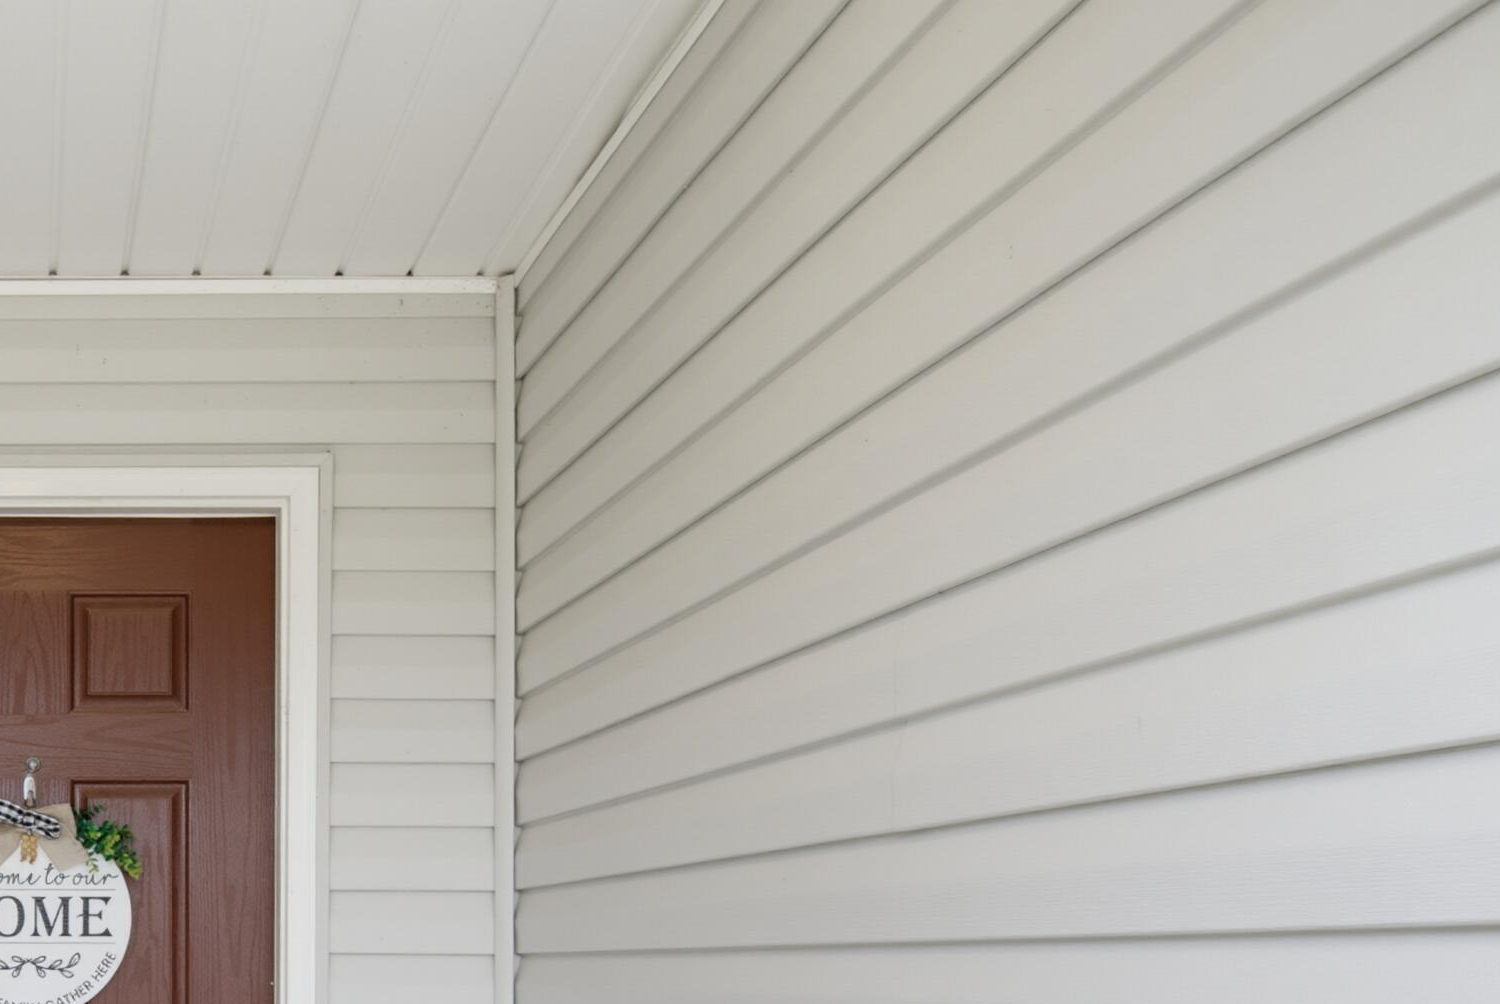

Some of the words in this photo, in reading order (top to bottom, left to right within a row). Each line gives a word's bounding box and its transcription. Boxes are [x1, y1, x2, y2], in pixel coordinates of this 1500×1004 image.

[44, 863, 69, 886] to
[72, 870, 119, 886] our
[91, 951, 117, 982] HERE
